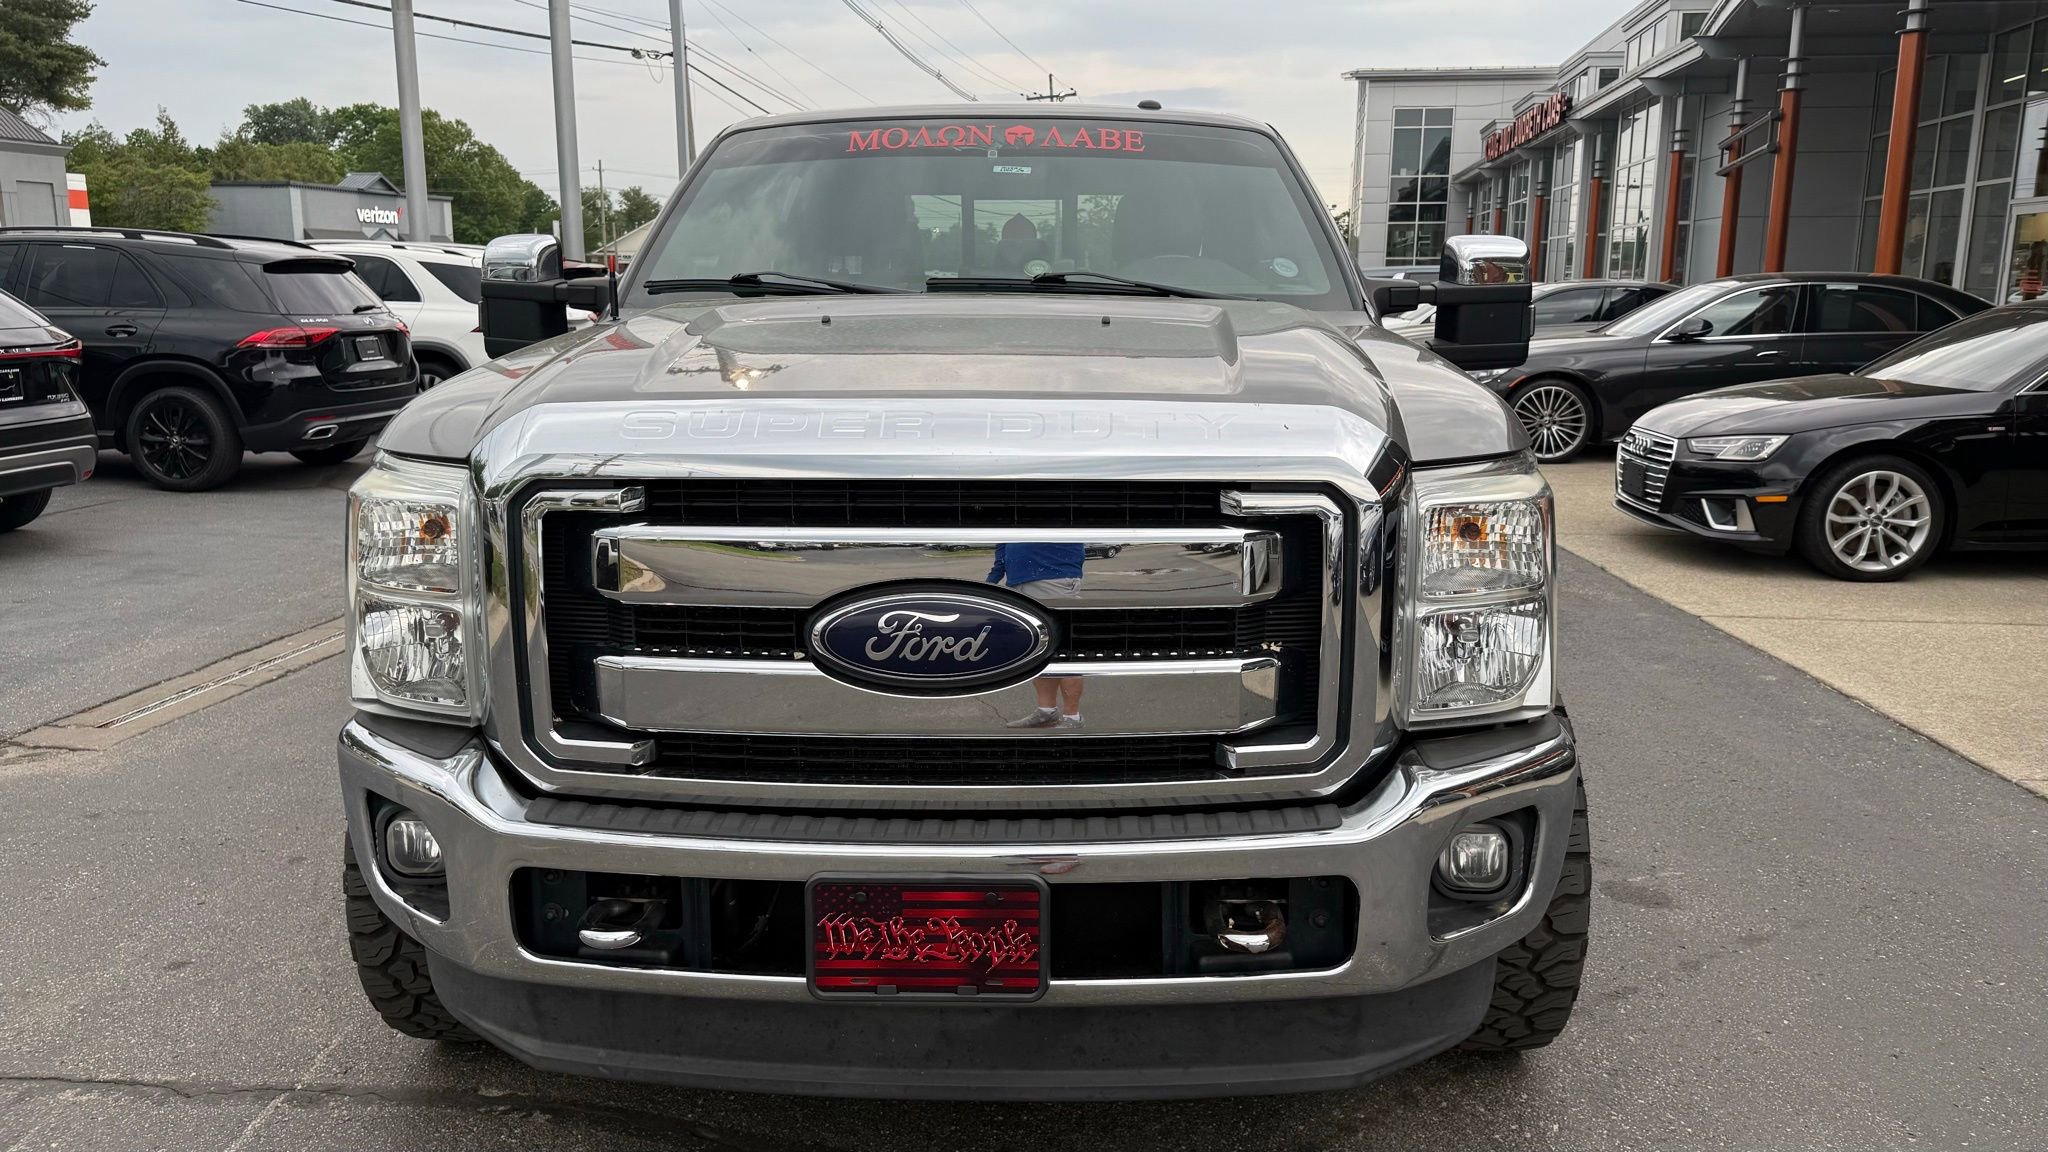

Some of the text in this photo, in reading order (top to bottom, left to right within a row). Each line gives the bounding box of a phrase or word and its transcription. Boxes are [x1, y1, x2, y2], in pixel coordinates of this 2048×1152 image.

[1542, 91, 1561, 131] CARS
[356, 206, 399, 224] verizon
[620, 410, 1239, 441] SUPER DUTY
[865, 610, 992, 661] Ford
[817, 912, 876, 960] We
[921, 916, 1038, 974] People
